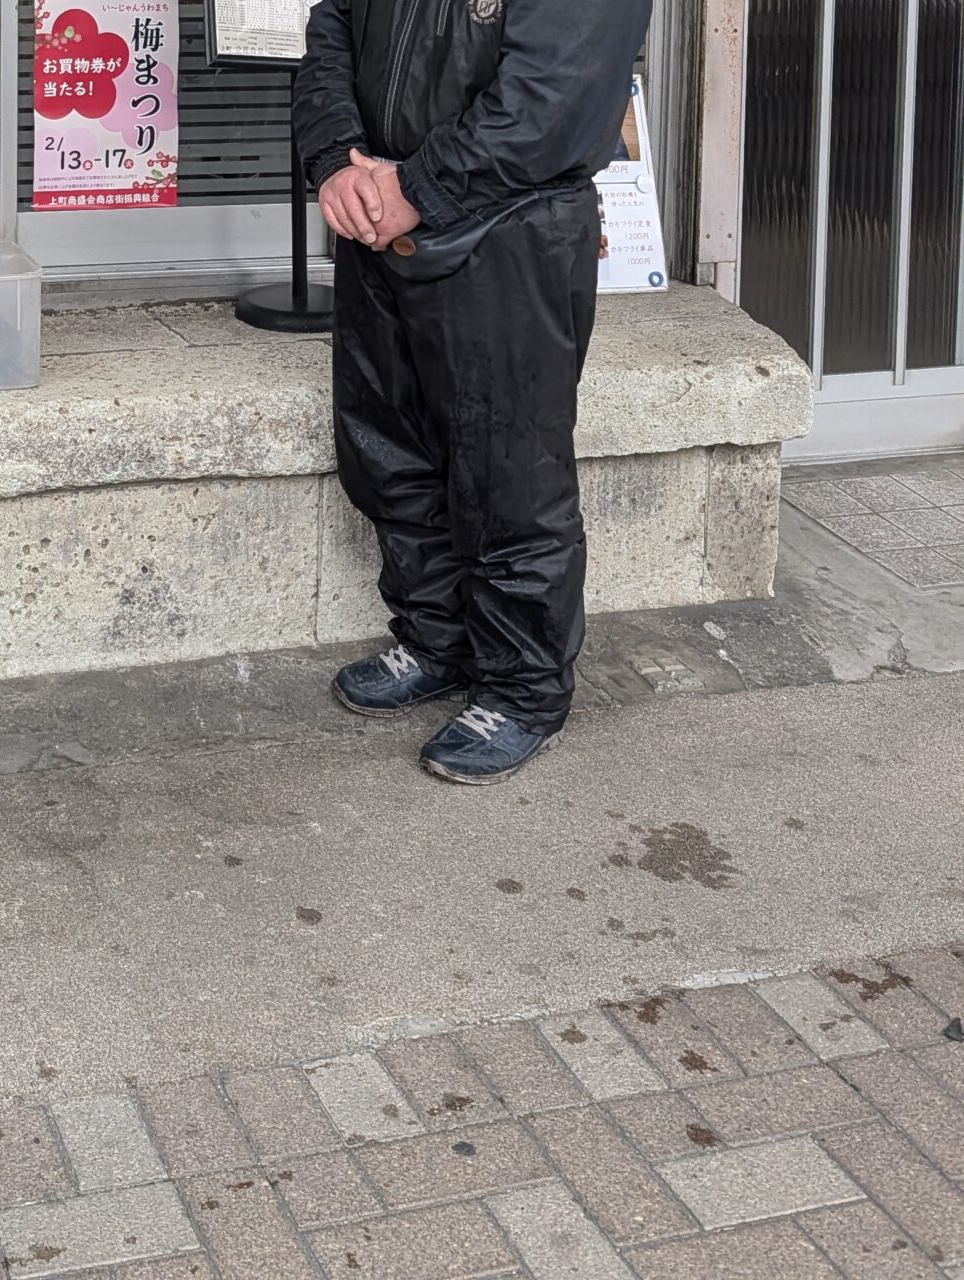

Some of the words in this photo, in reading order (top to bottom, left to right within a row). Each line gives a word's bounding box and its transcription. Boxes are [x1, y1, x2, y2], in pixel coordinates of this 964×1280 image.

[43, 57, 122, 74] お買物券が
[43, 81, 93, 97] 当たる!
[130, 17, 164, 156] 梅まつり
